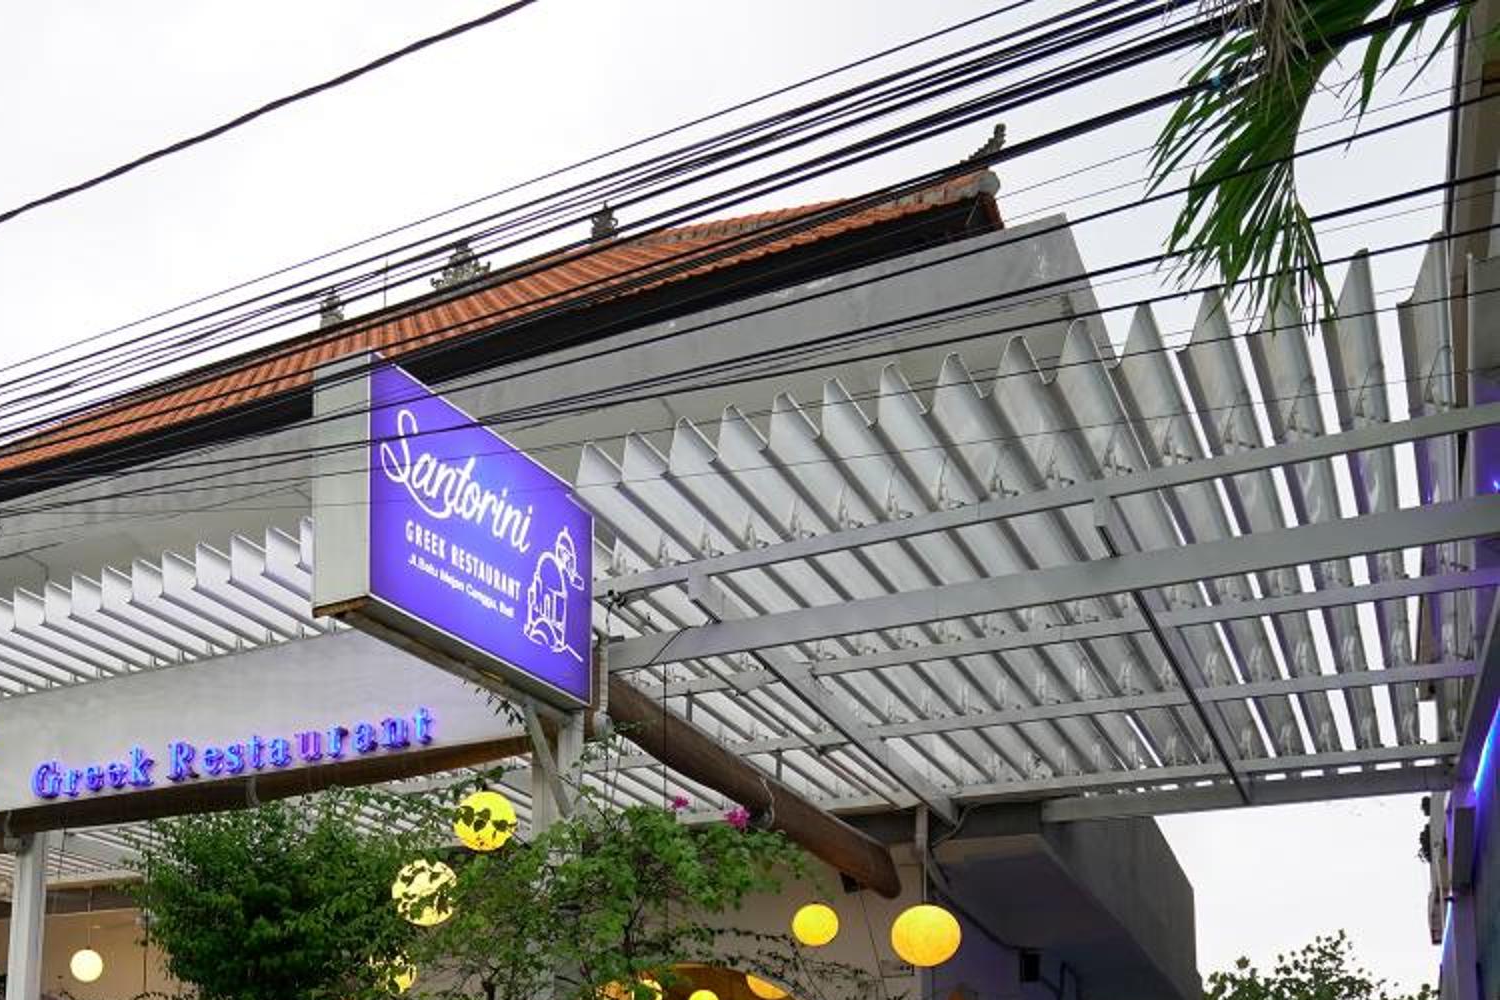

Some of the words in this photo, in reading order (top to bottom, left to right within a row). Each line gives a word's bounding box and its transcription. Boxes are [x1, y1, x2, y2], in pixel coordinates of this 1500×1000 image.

[380, 409, 533, 553] Santorini
[405, 519, 447, 560] GREEK
[451, 543, 521, 602] RESTAURANT
[32, 744, 156, 799] Greek
[166, 706, 435, 782] Restaurant
